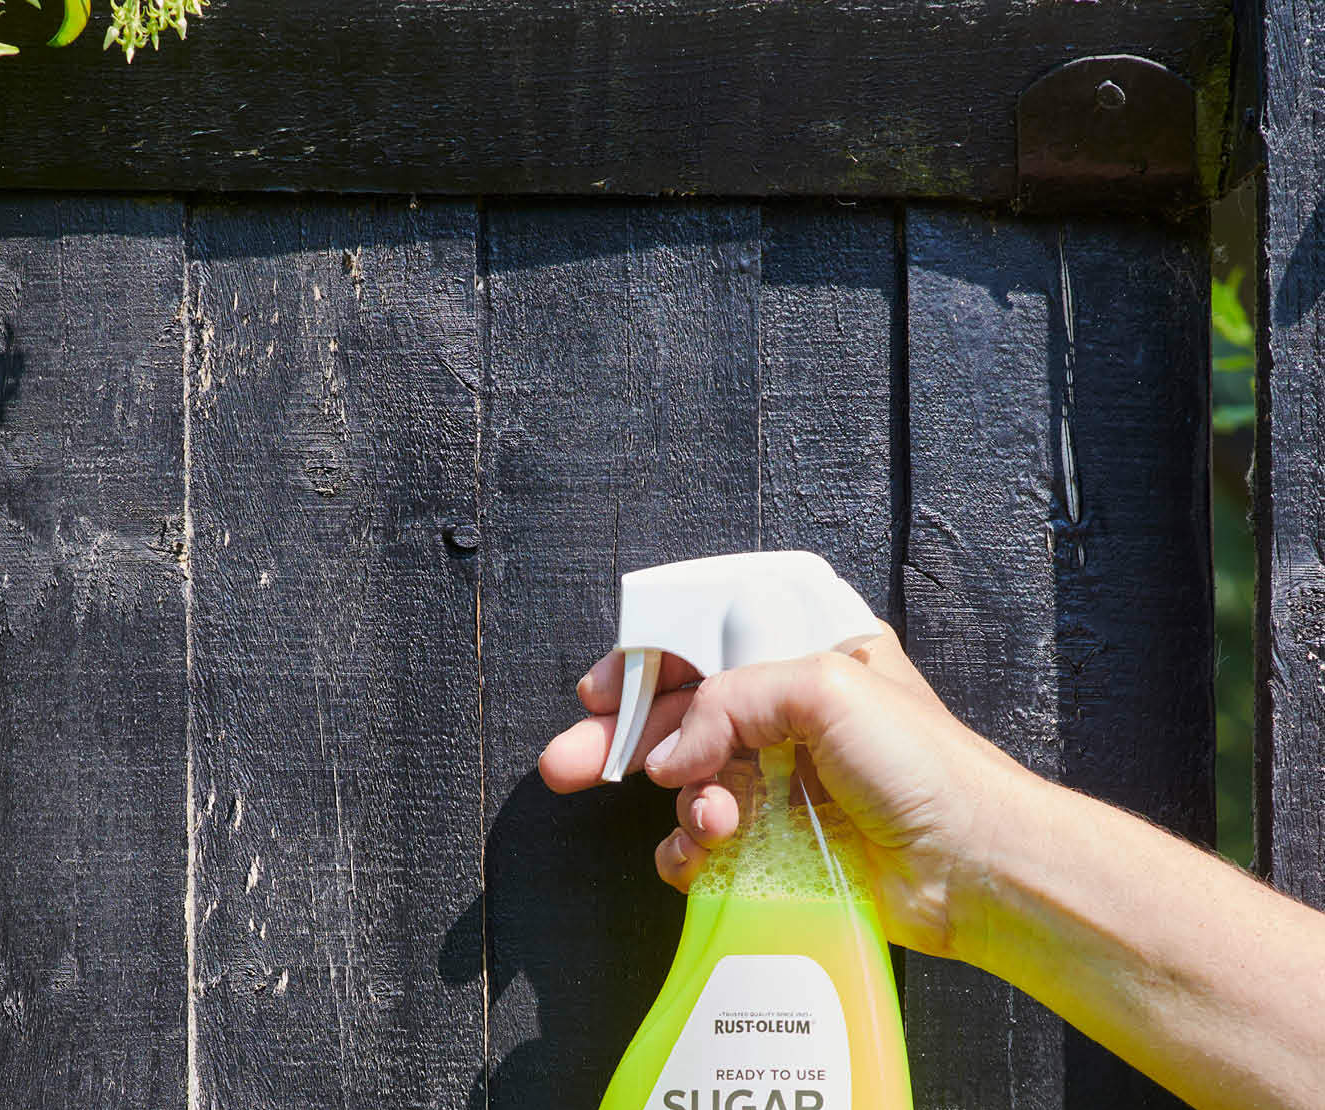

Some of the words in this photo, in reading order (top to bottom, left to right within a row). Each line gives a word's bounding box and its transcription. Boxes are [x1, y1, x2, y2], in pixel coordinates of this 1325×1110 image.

[716, 1069, 765, 1081] READY
[770, 1069, 791, 1081] TO
[797, 1069, 826, 1081] USE
